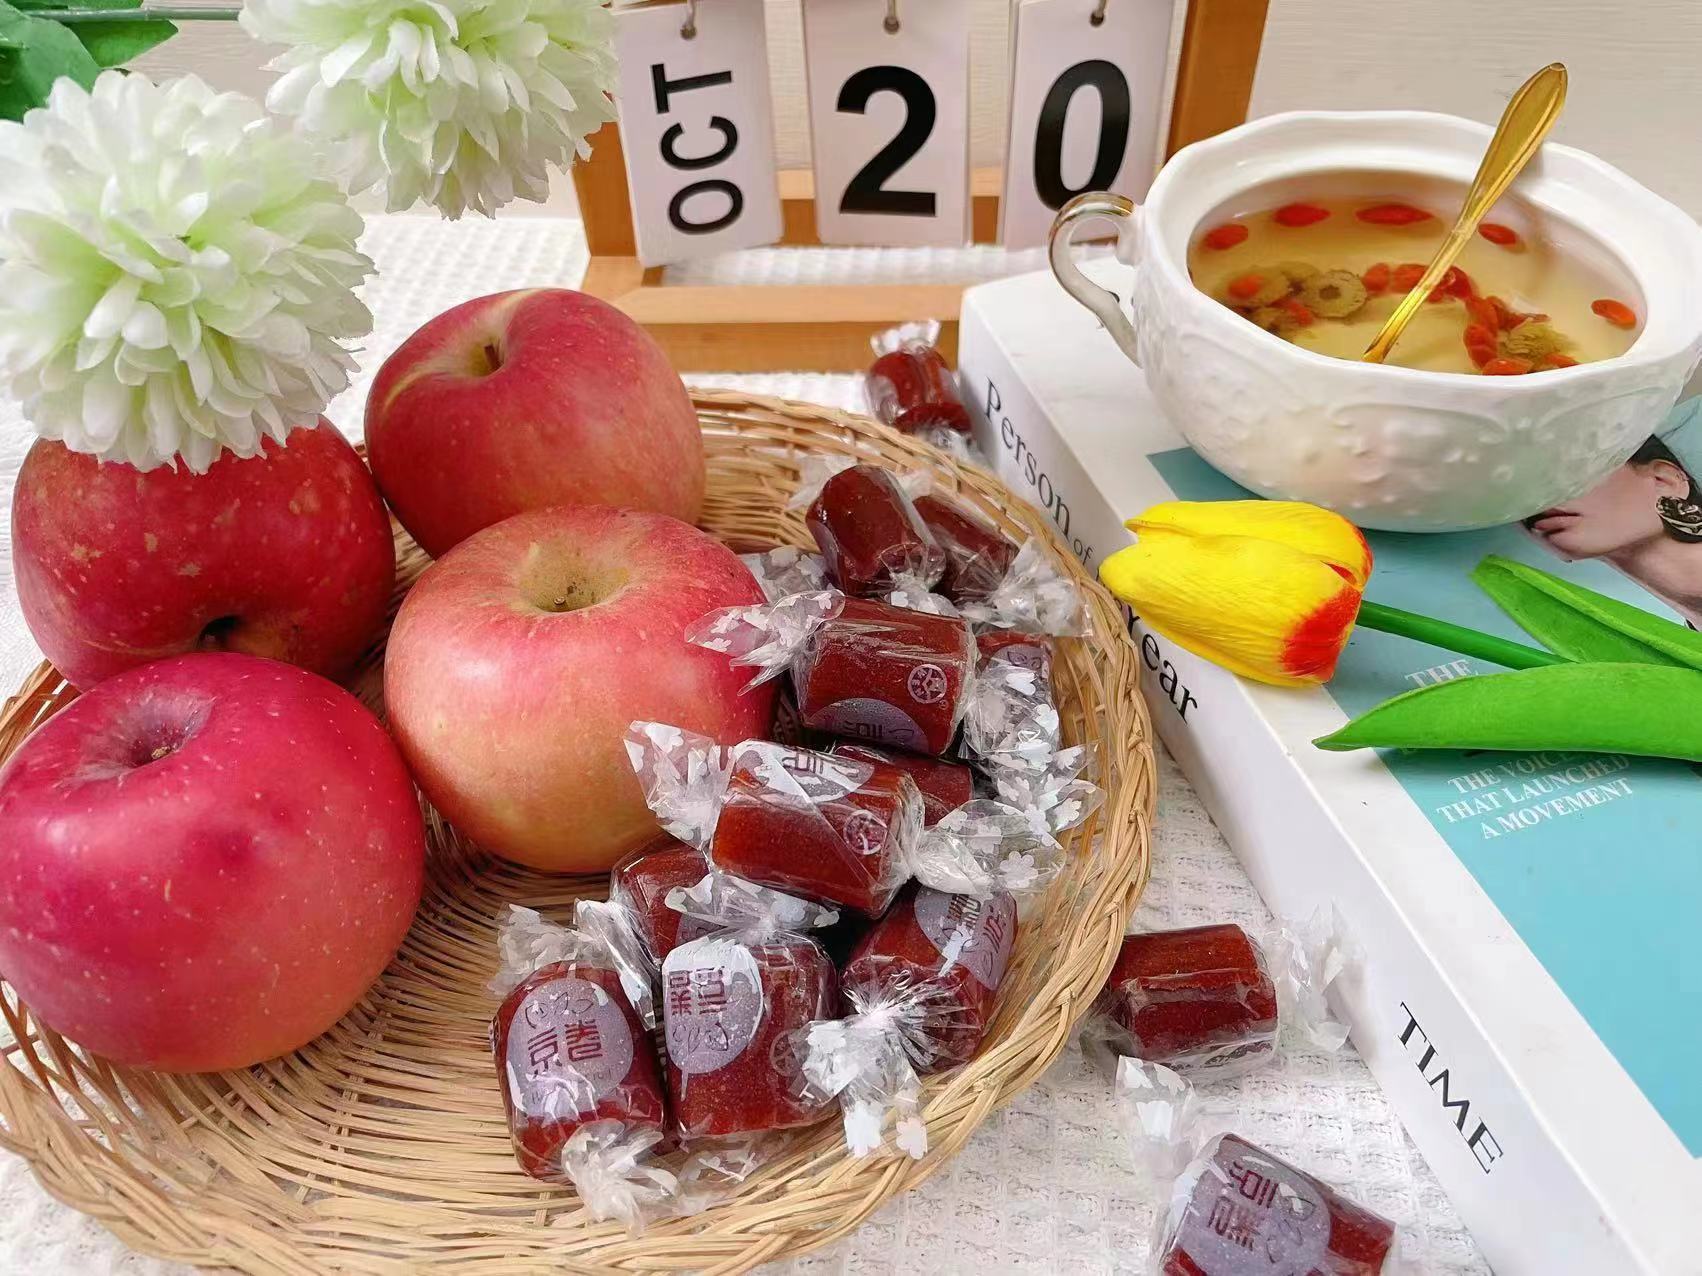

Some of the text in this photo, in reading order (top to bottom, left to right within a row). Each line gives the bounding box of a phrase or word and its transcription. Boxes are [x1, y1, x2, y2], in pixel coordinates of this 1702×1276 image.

[650, 62, 744, 235] OCT
[835, 59, 1131, 218] 2 0
[985, 375, 1071, 542] Person
[1073, 538, 1094, 566] of
[1436, 755, 1630, 823] THAT LAUNCHED
[1447, 768, 1501, 794] THE
[1481, 777, 1634, 840] A MOVEMENT
[1398, 1001, 1504, 1175] TIME
